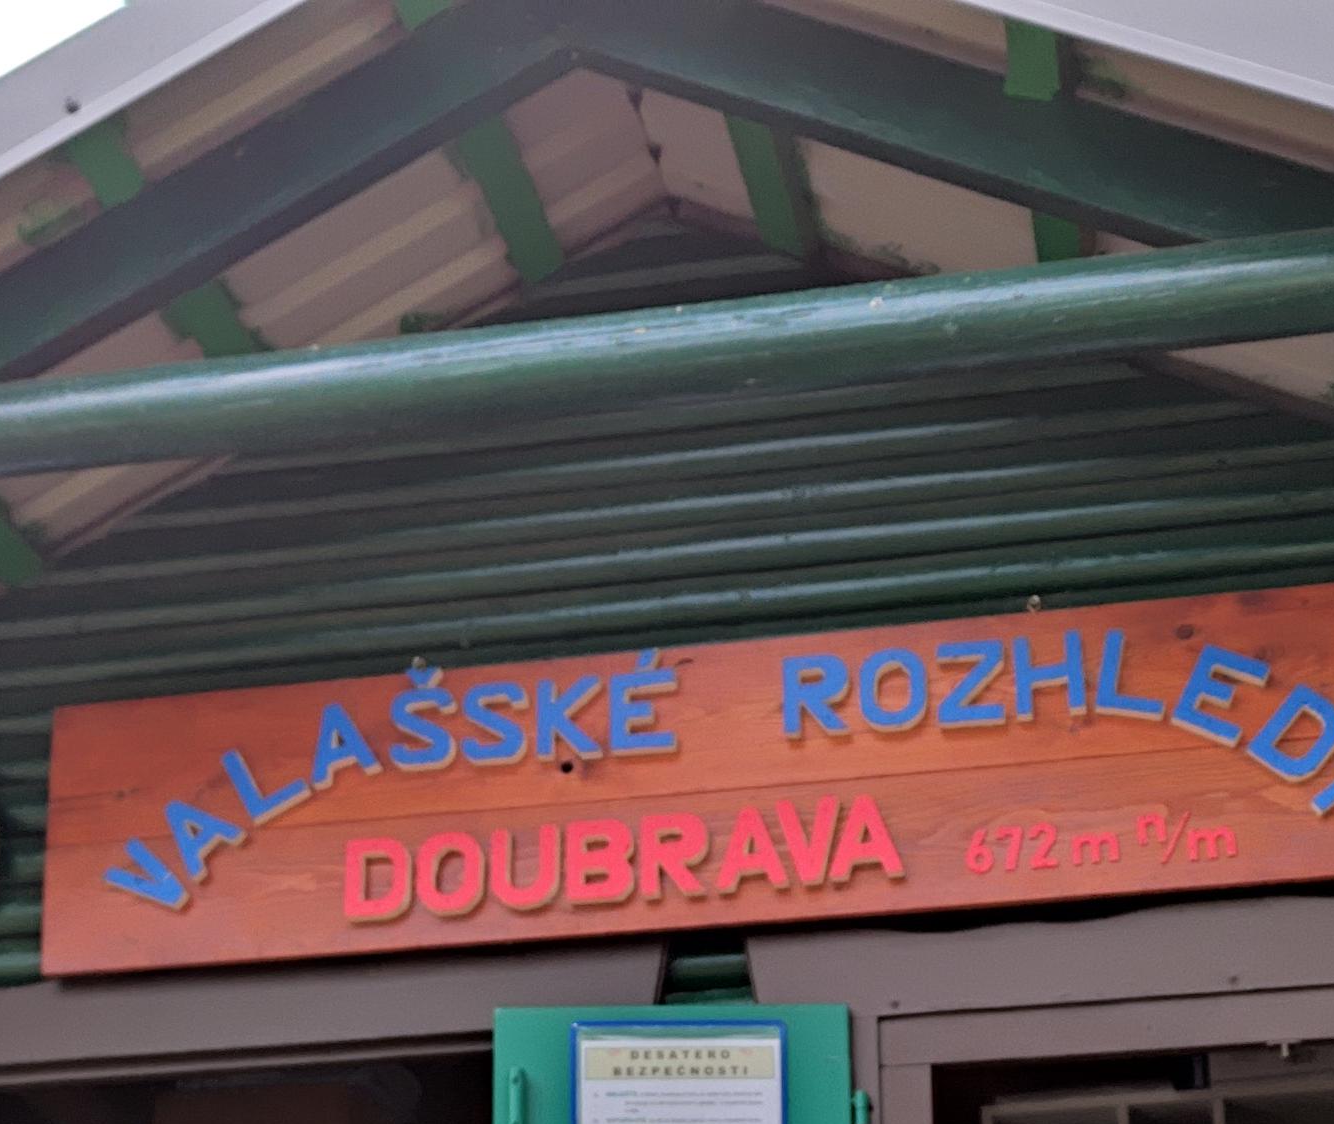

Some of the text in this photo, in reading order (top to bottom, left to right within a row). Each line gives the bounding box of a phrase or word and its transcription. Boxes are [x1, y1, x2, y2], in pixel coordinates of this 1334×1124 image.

[104, 648, 678, 911] VALAŠSKÉ
[343, 795, 906, 923] DOUBRAVA
[968, 825, 1059, 874] 672
[613, 1065, 749, 1077] BEZPEČNOSTI
[630, 1049, 731, 1060] DESATERO
